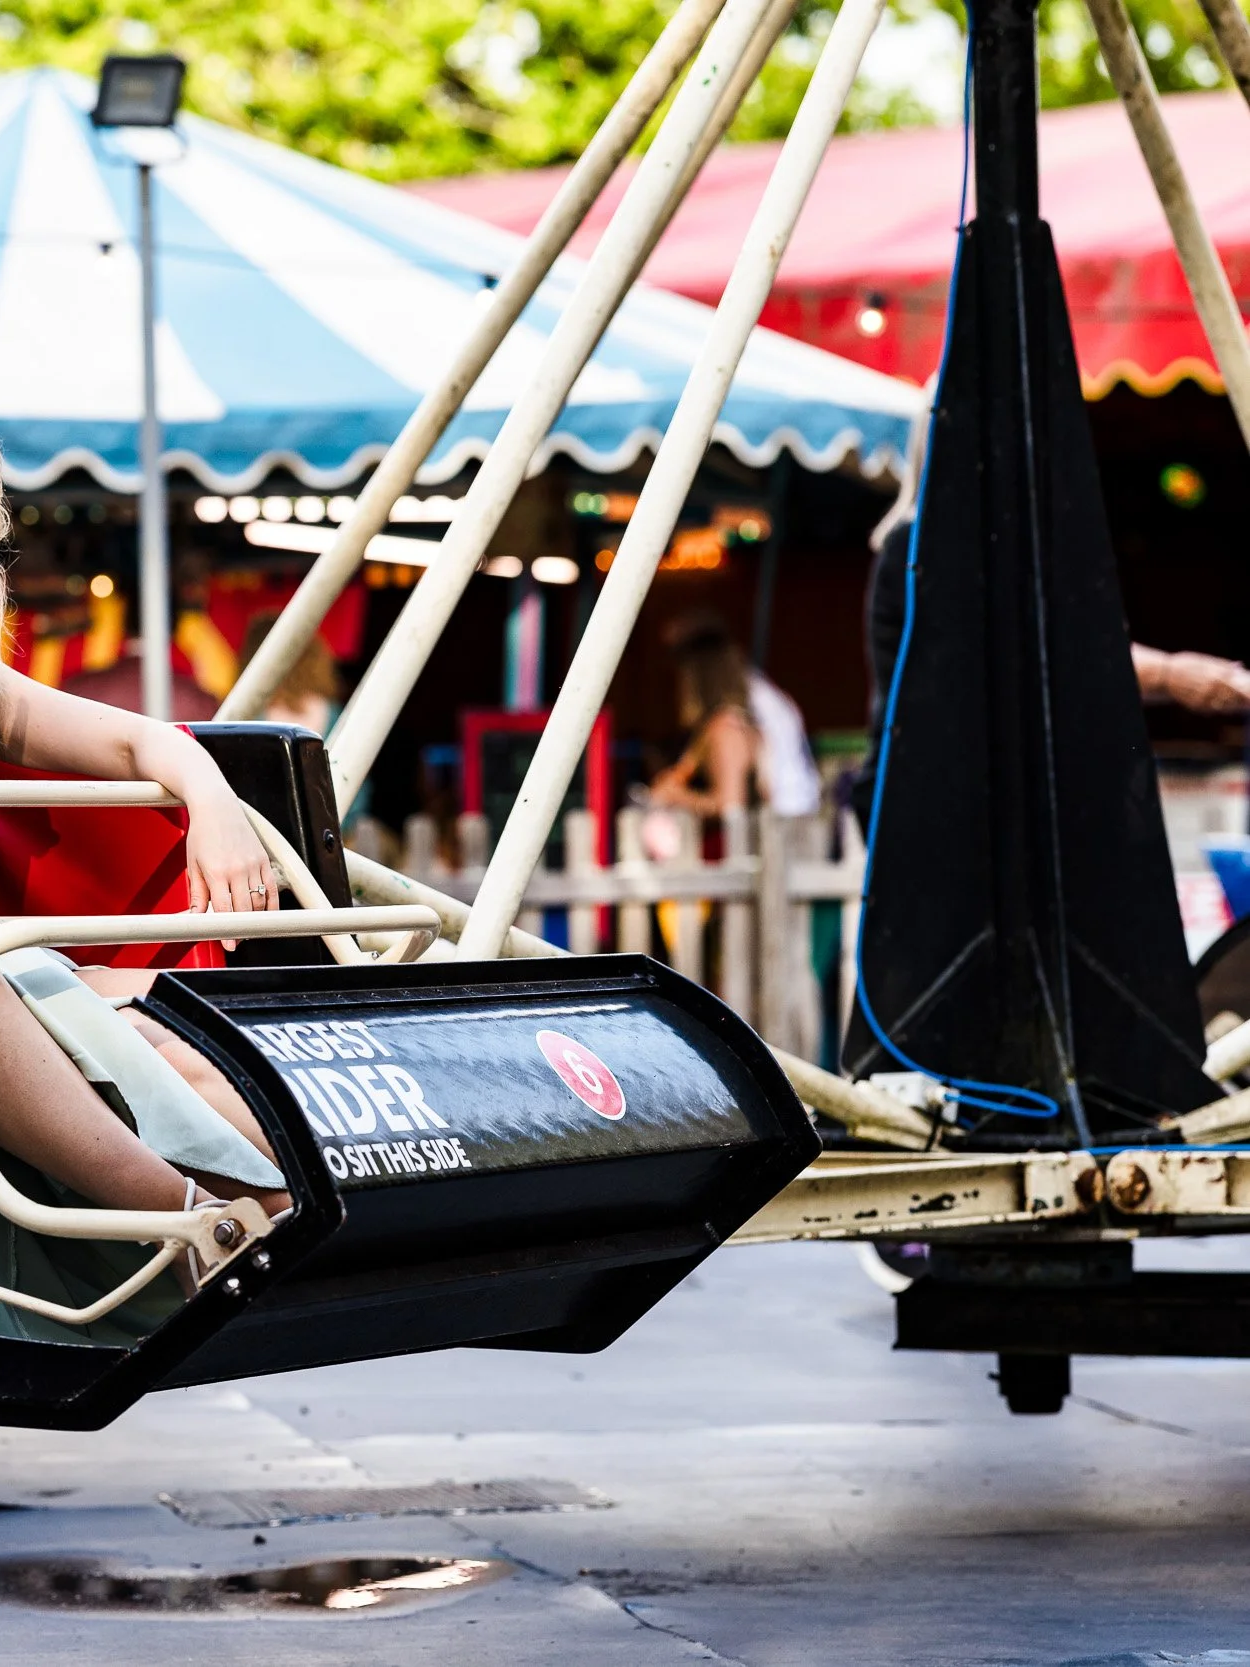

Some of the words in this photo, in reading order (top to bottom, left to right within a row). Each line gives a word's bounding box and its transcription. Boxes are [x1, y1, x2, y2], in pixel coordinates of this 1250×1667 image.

[238, 1021, 392, 1063] ARGEST
[562, 1049, 604, 1095] 6
[322, 1145, 350, 1181] O
[343, 1143, 382, 1179] SIT
[371, 1140, 428, 1175] THIS
[420, 1137, 473, 1172] SIDE
